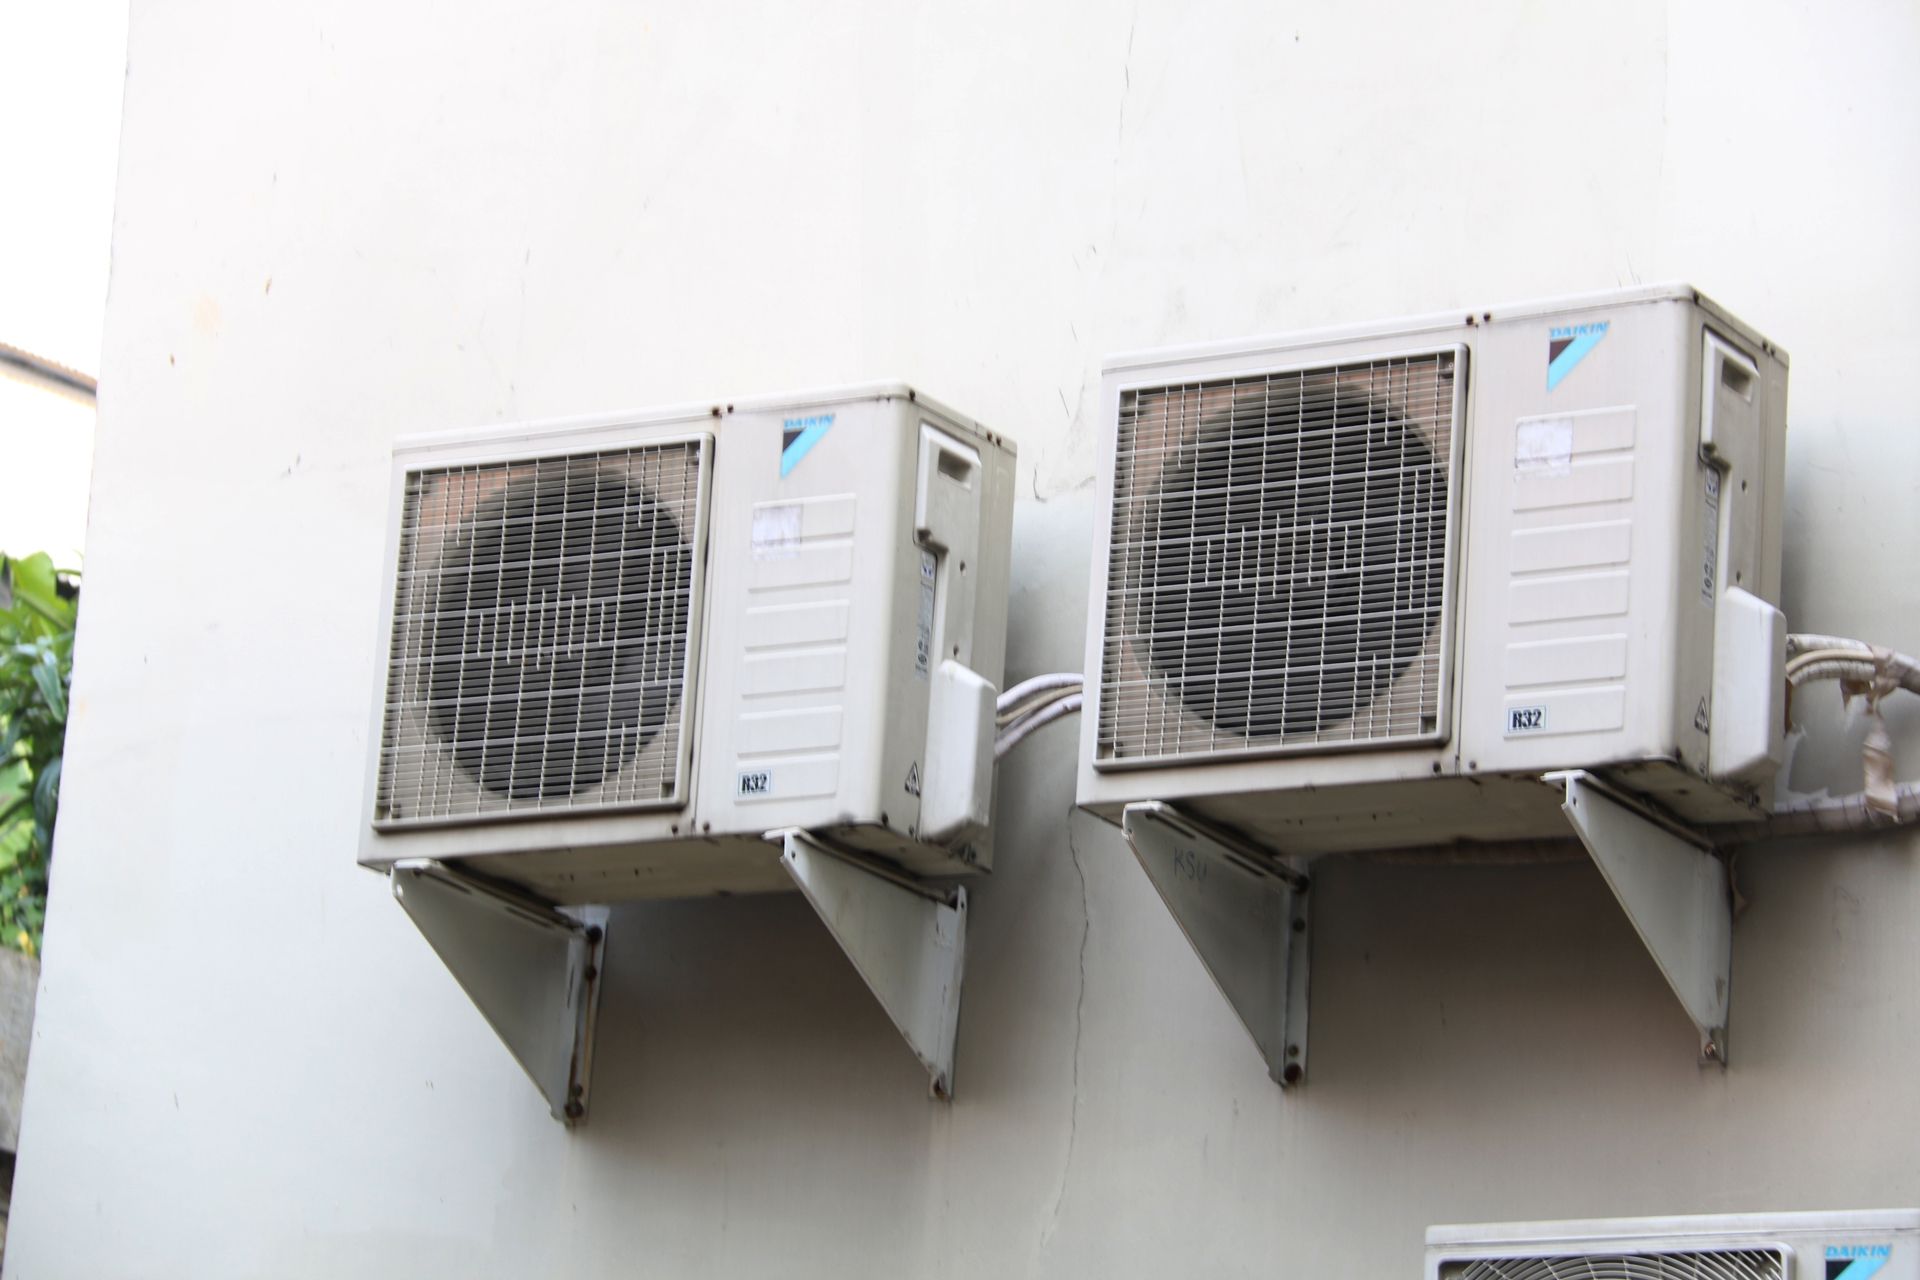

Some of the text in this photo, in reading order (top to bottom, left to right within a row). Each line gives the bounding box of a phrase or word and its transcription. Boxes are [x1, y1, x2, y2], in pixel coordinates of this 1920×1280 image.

[1549, 320, 1610, 337] DAIKIN
[783, 413, 835, 429] DAIKIN
[1512, 708, 1542, 730] R32
[741, 773, 767, 793] R32
[1825, 1243, 1891, 1257] DAIKIN
